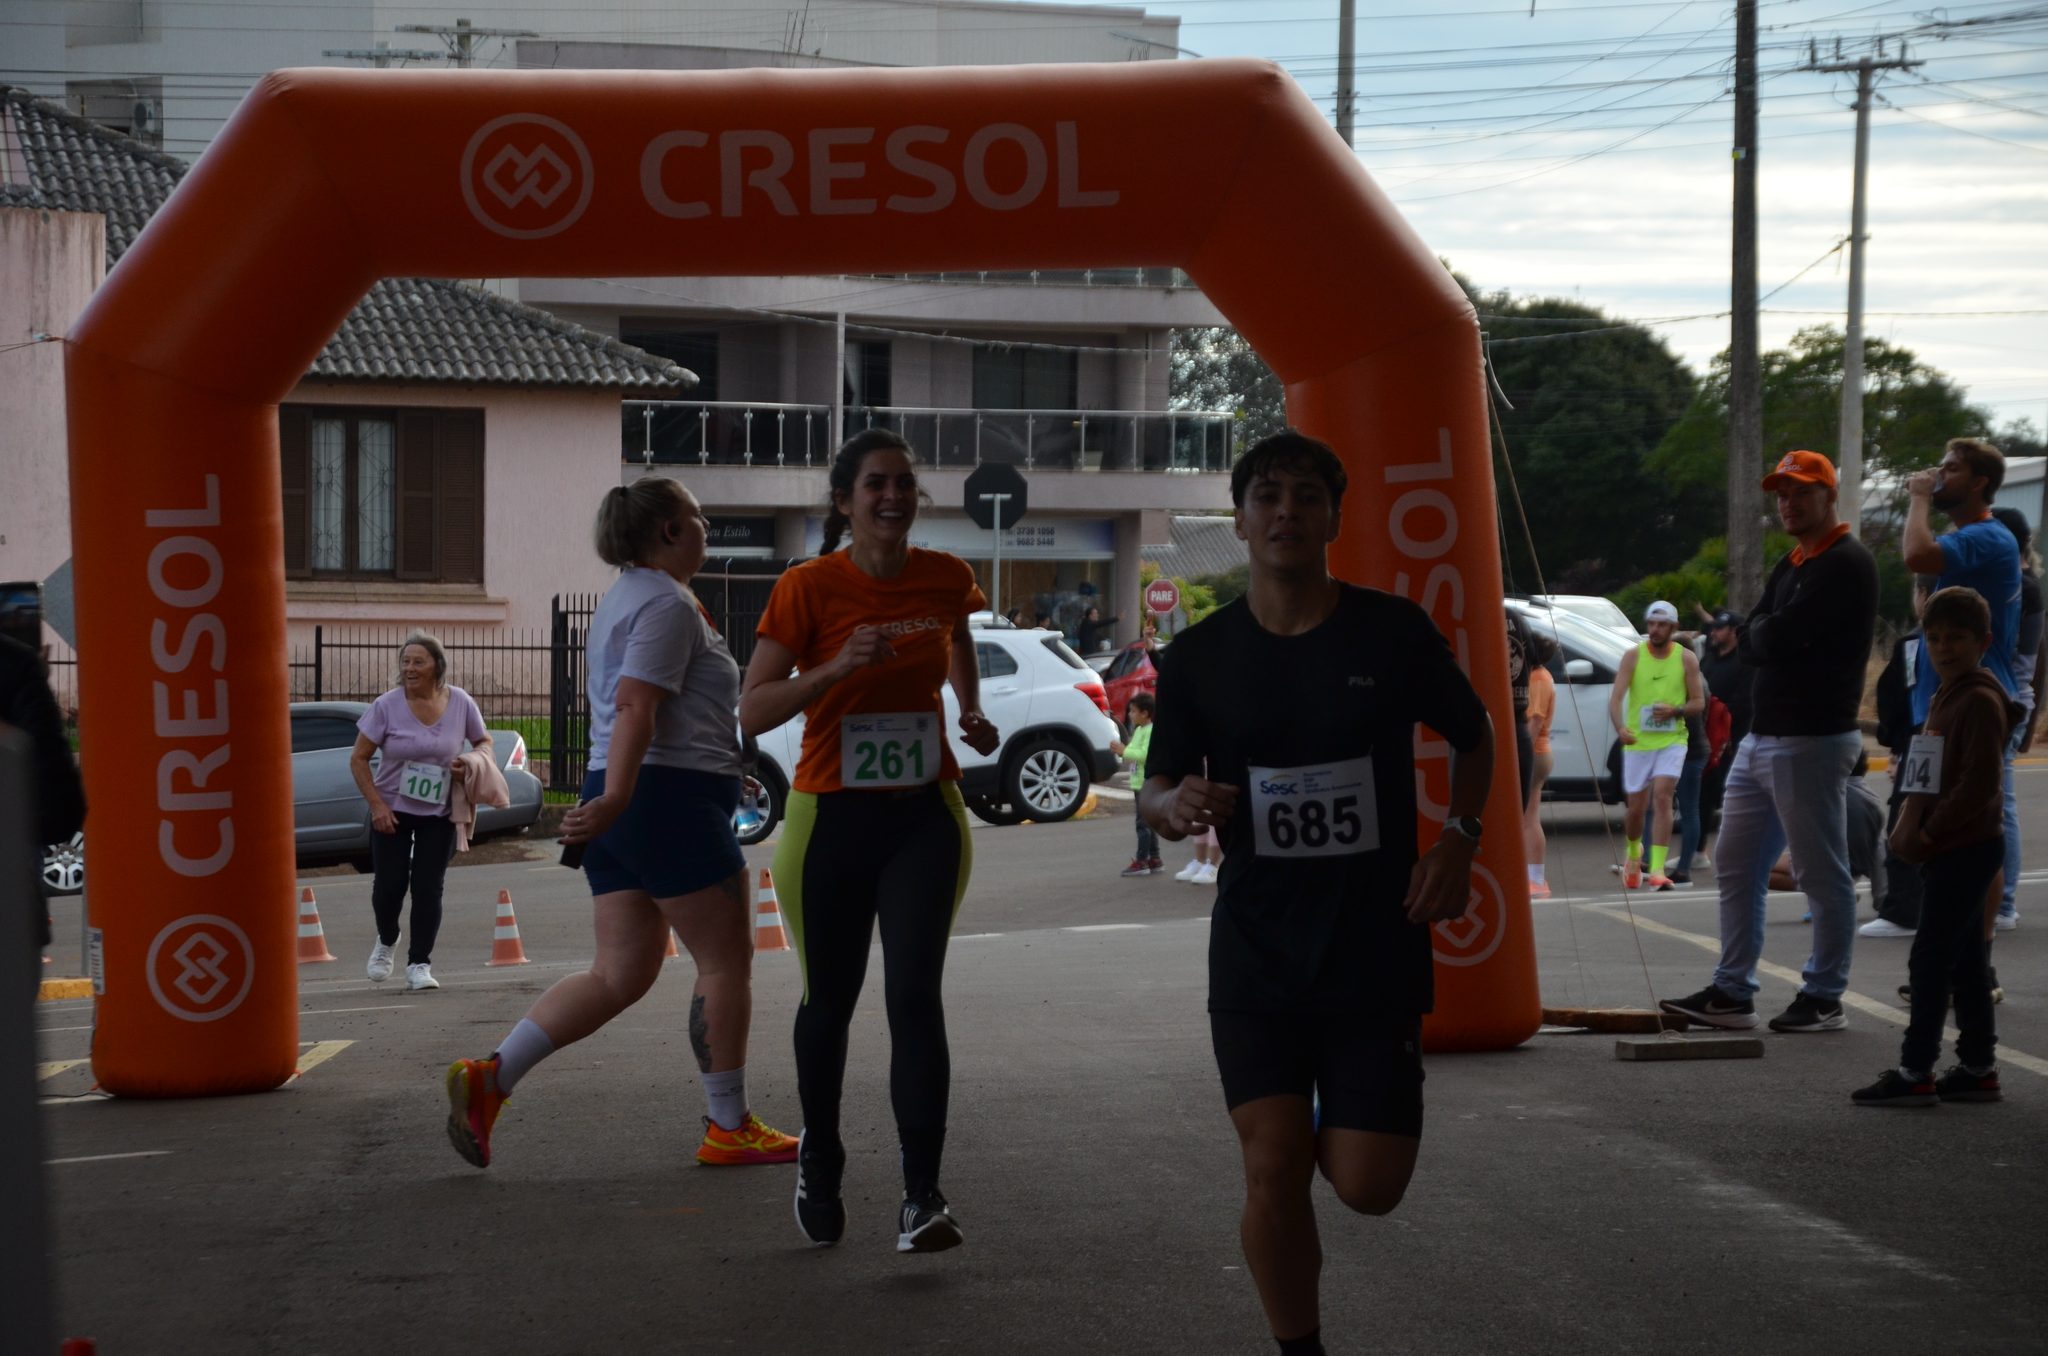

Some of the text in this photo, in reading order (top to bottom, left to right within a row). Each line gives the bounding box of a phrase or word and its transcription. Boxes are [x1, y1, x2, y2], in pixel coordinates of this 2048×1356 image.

[639, 120, 1121, 220] CRESOL
[723, 525, 751, 537] Estilo
[1151, 590, 1173, 602] PARE
[1384, 427, 1472, 823] CSOL
[144, 473, 235, 878] CRESOL
[1347, 675, 1376, 686] FILA
[855, 739, 924, 780] 261
[1906, 757, 1931, 788] 04
[407, 776, 442, 801] 101
[1259, 780, 1299, 796] Sesc
[1268, 795, 1362, 849] 685
